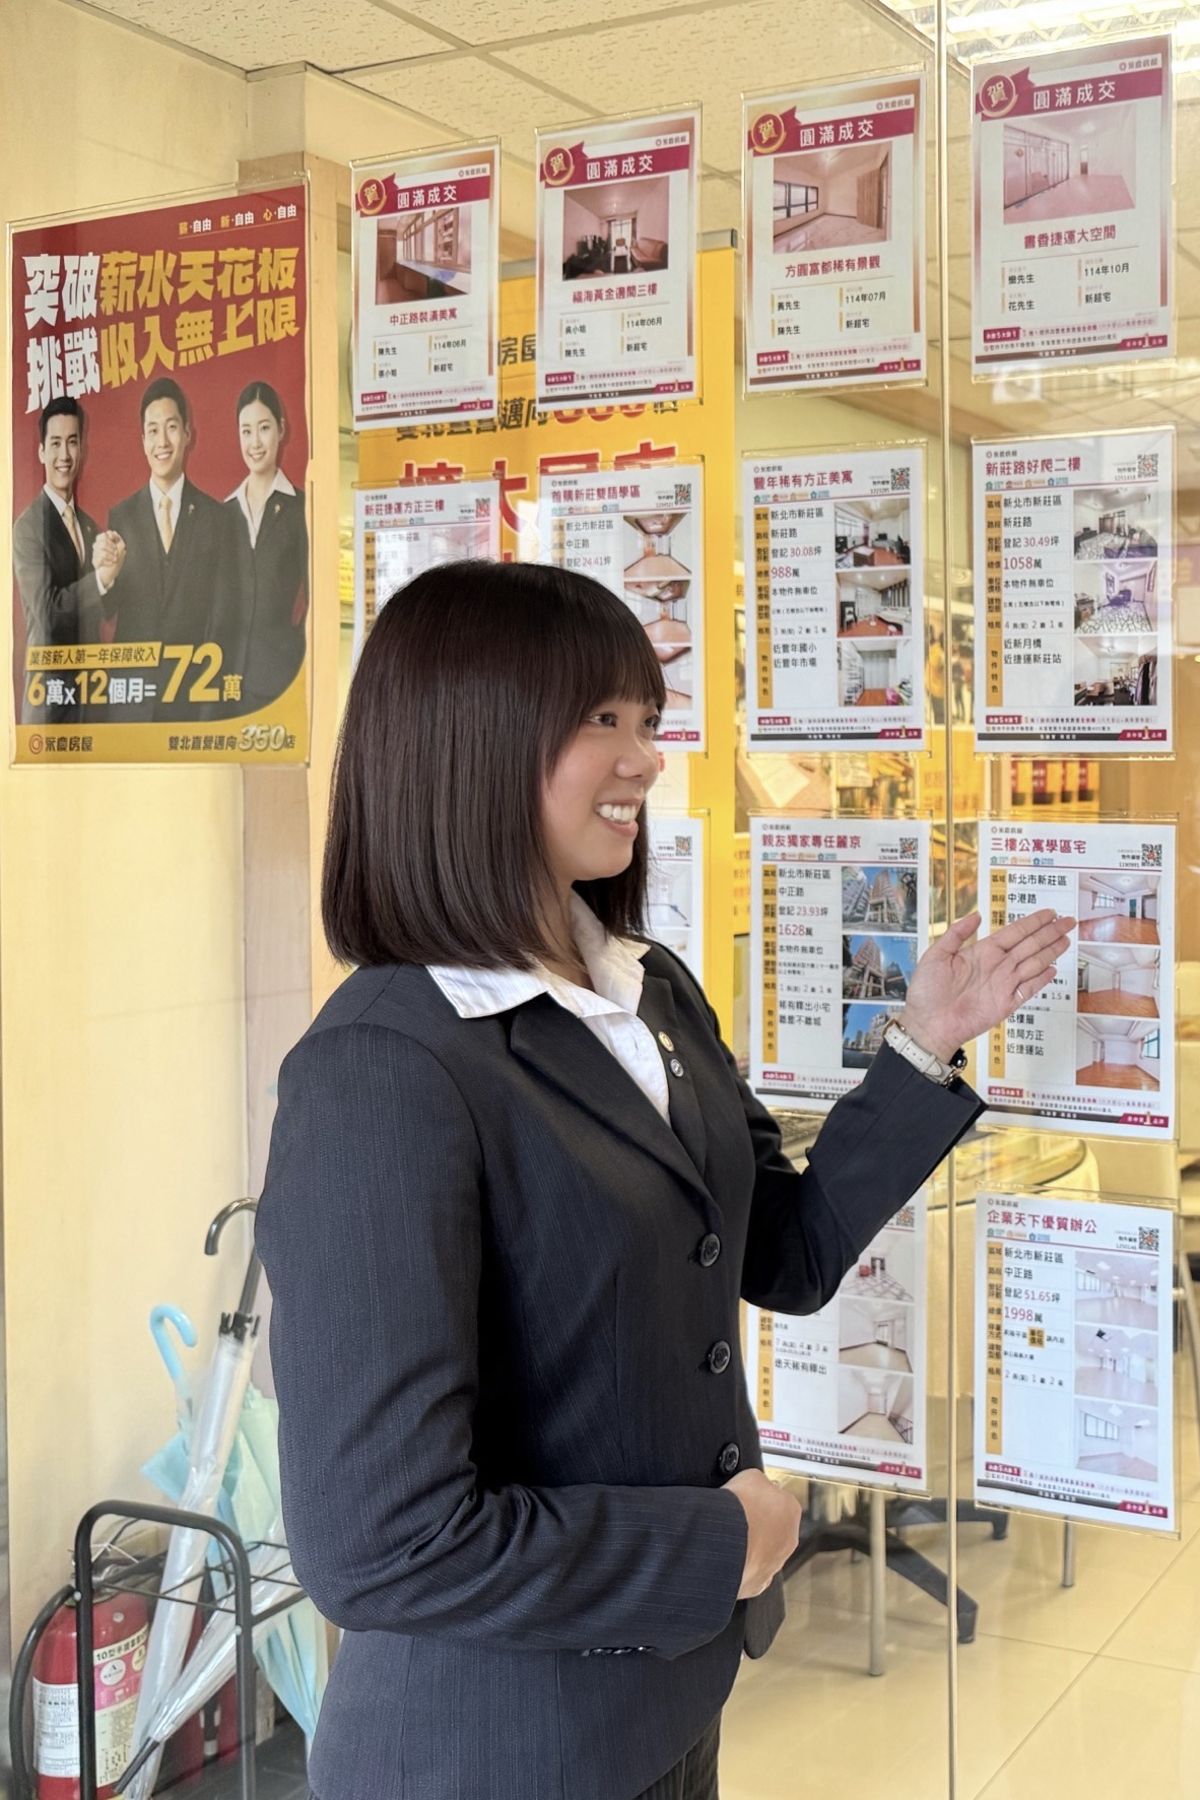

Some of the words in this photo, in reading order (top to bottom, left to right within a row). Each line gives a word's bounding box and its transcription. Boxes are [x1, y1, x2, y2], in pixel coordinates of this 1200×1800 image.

[1033, 81, 1116, 110] 圓滿成交
[800, 120, 874, 147] 圓滿成交
[586, 155, 653, 181] 圓滿成交
[397, 185, 457, 208] 圓滿成交
[1024, 225, 1116, 249] 書香捷運大空間
[1084, 263, 1130, 277] 114年10月
[22, 247, 299, 330] 突破薪水天花板
[1008, 300, 1035, 311] 花先生
[25, 296, 300, 414] 挑戰收入無上限
[986, 457, 1081, 477] 新莊路好爬二樓
[1003, 495, 1062, 508] 新北市新莊區
[771, 508, 824, 521] 新北市新莊區
[1003, 517, 1032, 528] 新莊路
[771, 529, 797, 539] 新莊路
[1003, 557, 1042, 570] 1058萬
[1003, 578, 1054, 589] 本物件無車位
[1004, 638, 1042, 650] 近新月橋
[1004, 653, 1062, 665] 近捷運新莊站
[991, 838, 1086, 854] 三樓公寓學區宅
[778, 868, 831, 880] 新北市新莊區
[1008, 873, 1067, 887] 新北市新莊區
[778, 886, 804, 898] 中正路
[1008, 893, 1037, 905] 中港路
[778, 924, 813, 937] 1628萬
[1007, 1029, 1044, 1041] 格局方正
[1007, 1044, 1044, 1056] 近捷運站
[987, 1209, 1098, 1234] 企業天下優質辦公
[1005, 1246, 1064, 1264] 新北市新莊區
[1005, 1267, 1033, 1280] 中正路
[1004, 1306, 1043, 1323] 1998萬
